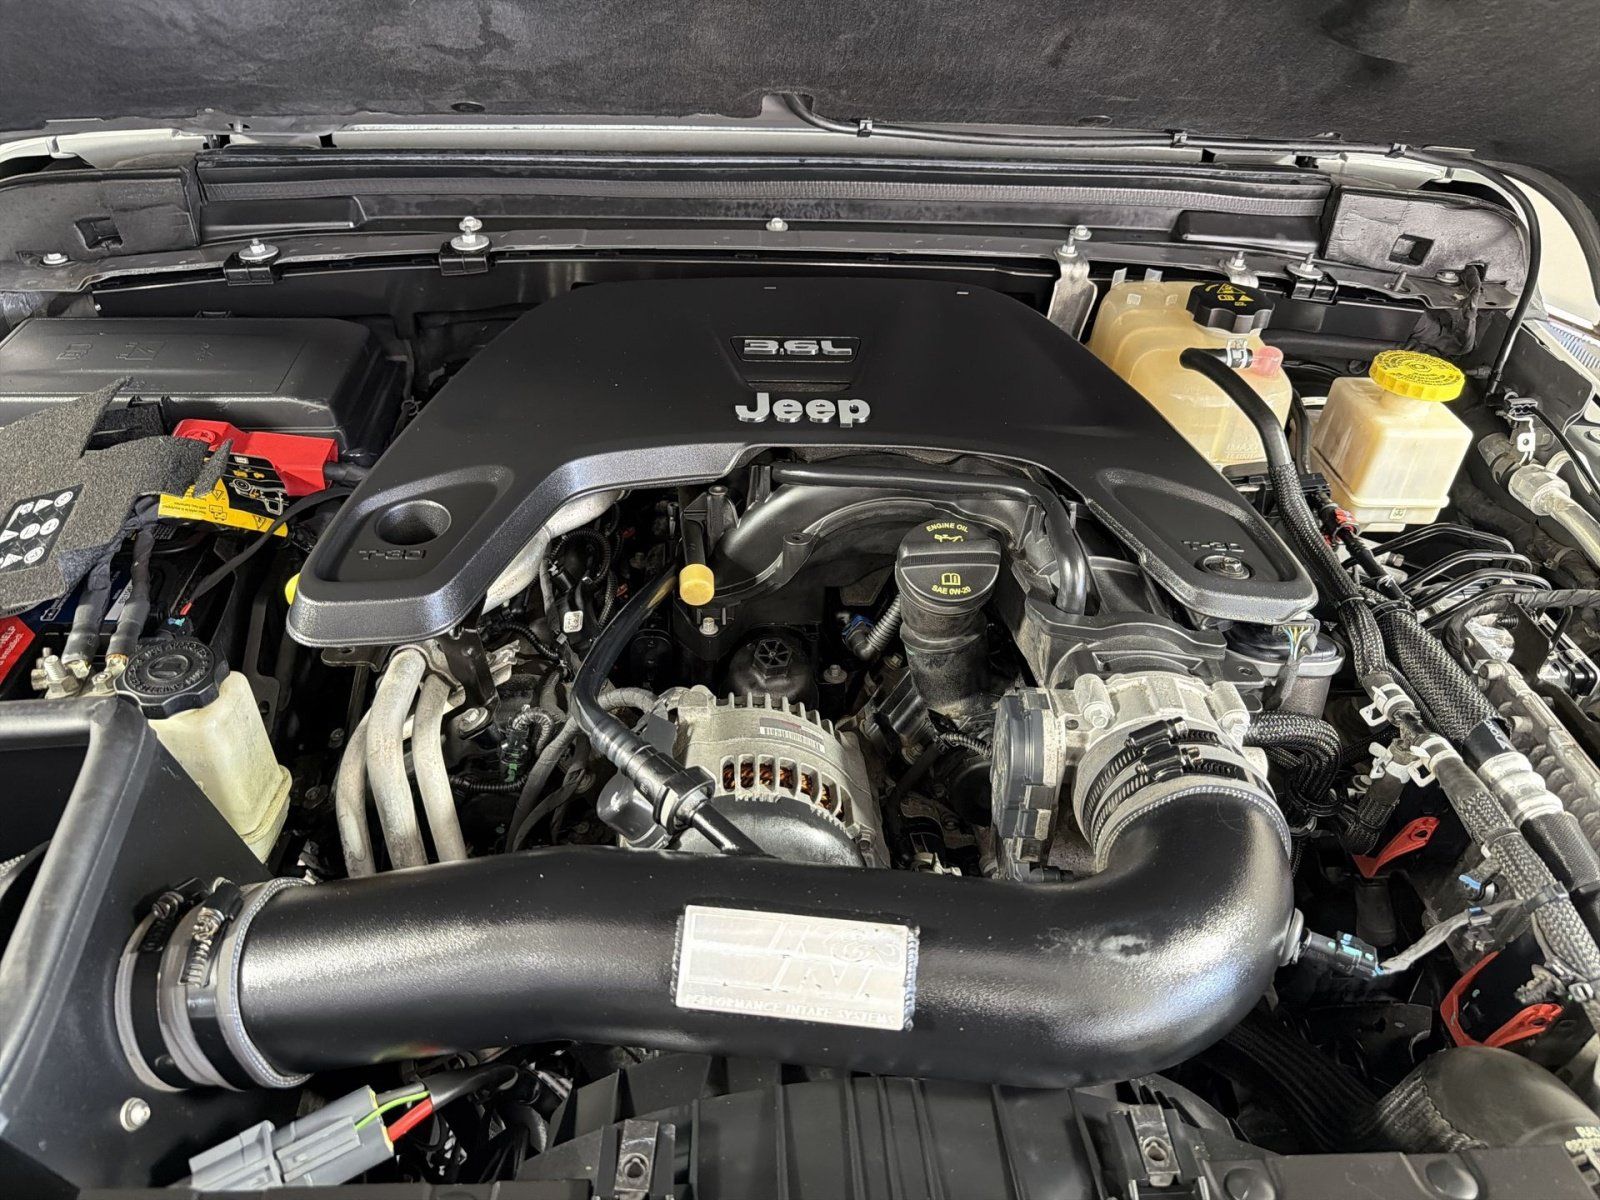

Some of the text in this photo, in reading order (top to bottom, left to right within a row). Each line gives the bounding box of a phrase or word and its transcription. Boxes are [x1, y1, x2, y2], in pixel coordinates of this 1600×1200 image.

[743, 339, 852, 355] 3.6L
[735, 392, 871, 428] Jeep
[926, 523, 968, 533] ENGINE OIL
[931, 585, 947, 594] SAE
[785, 1004, 832, 1018] INTAKE
[838, 1009, 897, 1026] SYSTEMS
